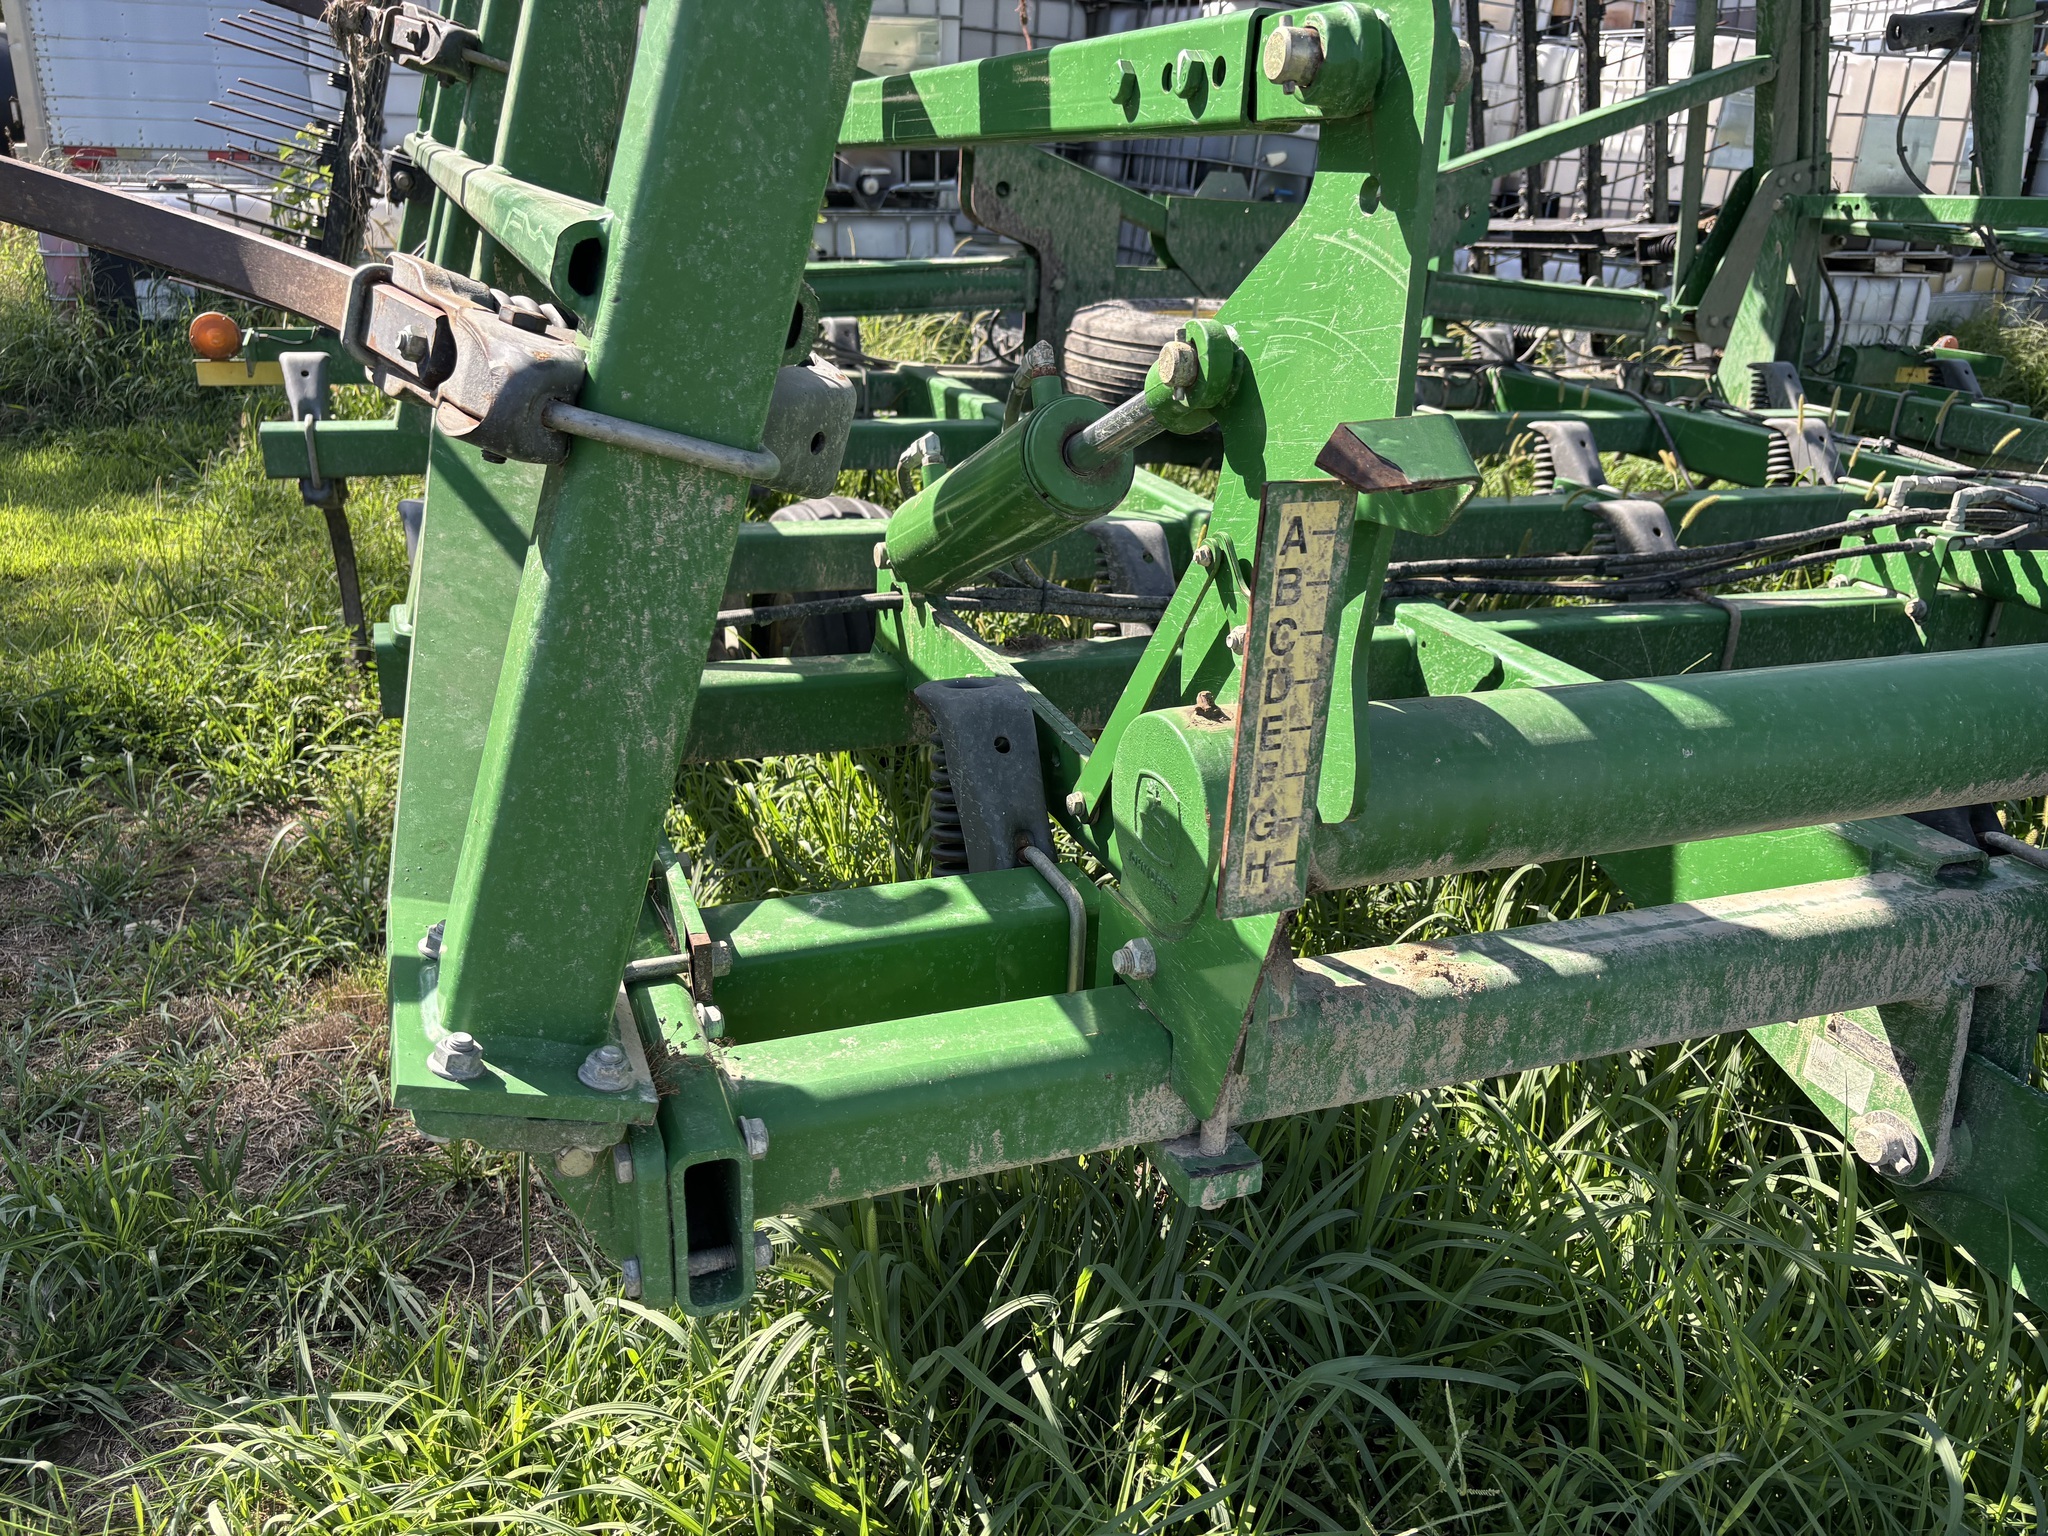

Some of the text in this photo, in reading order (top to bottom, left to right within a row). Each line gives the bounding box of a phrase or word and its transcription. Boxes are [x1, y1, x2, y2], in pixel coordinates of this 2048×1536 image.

[1279, 515, 1307, 556] A
[1275, 567, 1302, 607] B
[1270, 617, 1298, 656] C
[1264, 667, 1293, 704] D
[1260, 714, 1284, 751] E
[1254, 761, 1279, 798] F
[1250, 808, 1277, 842] G
[1245, 850, 1271, 883] H
